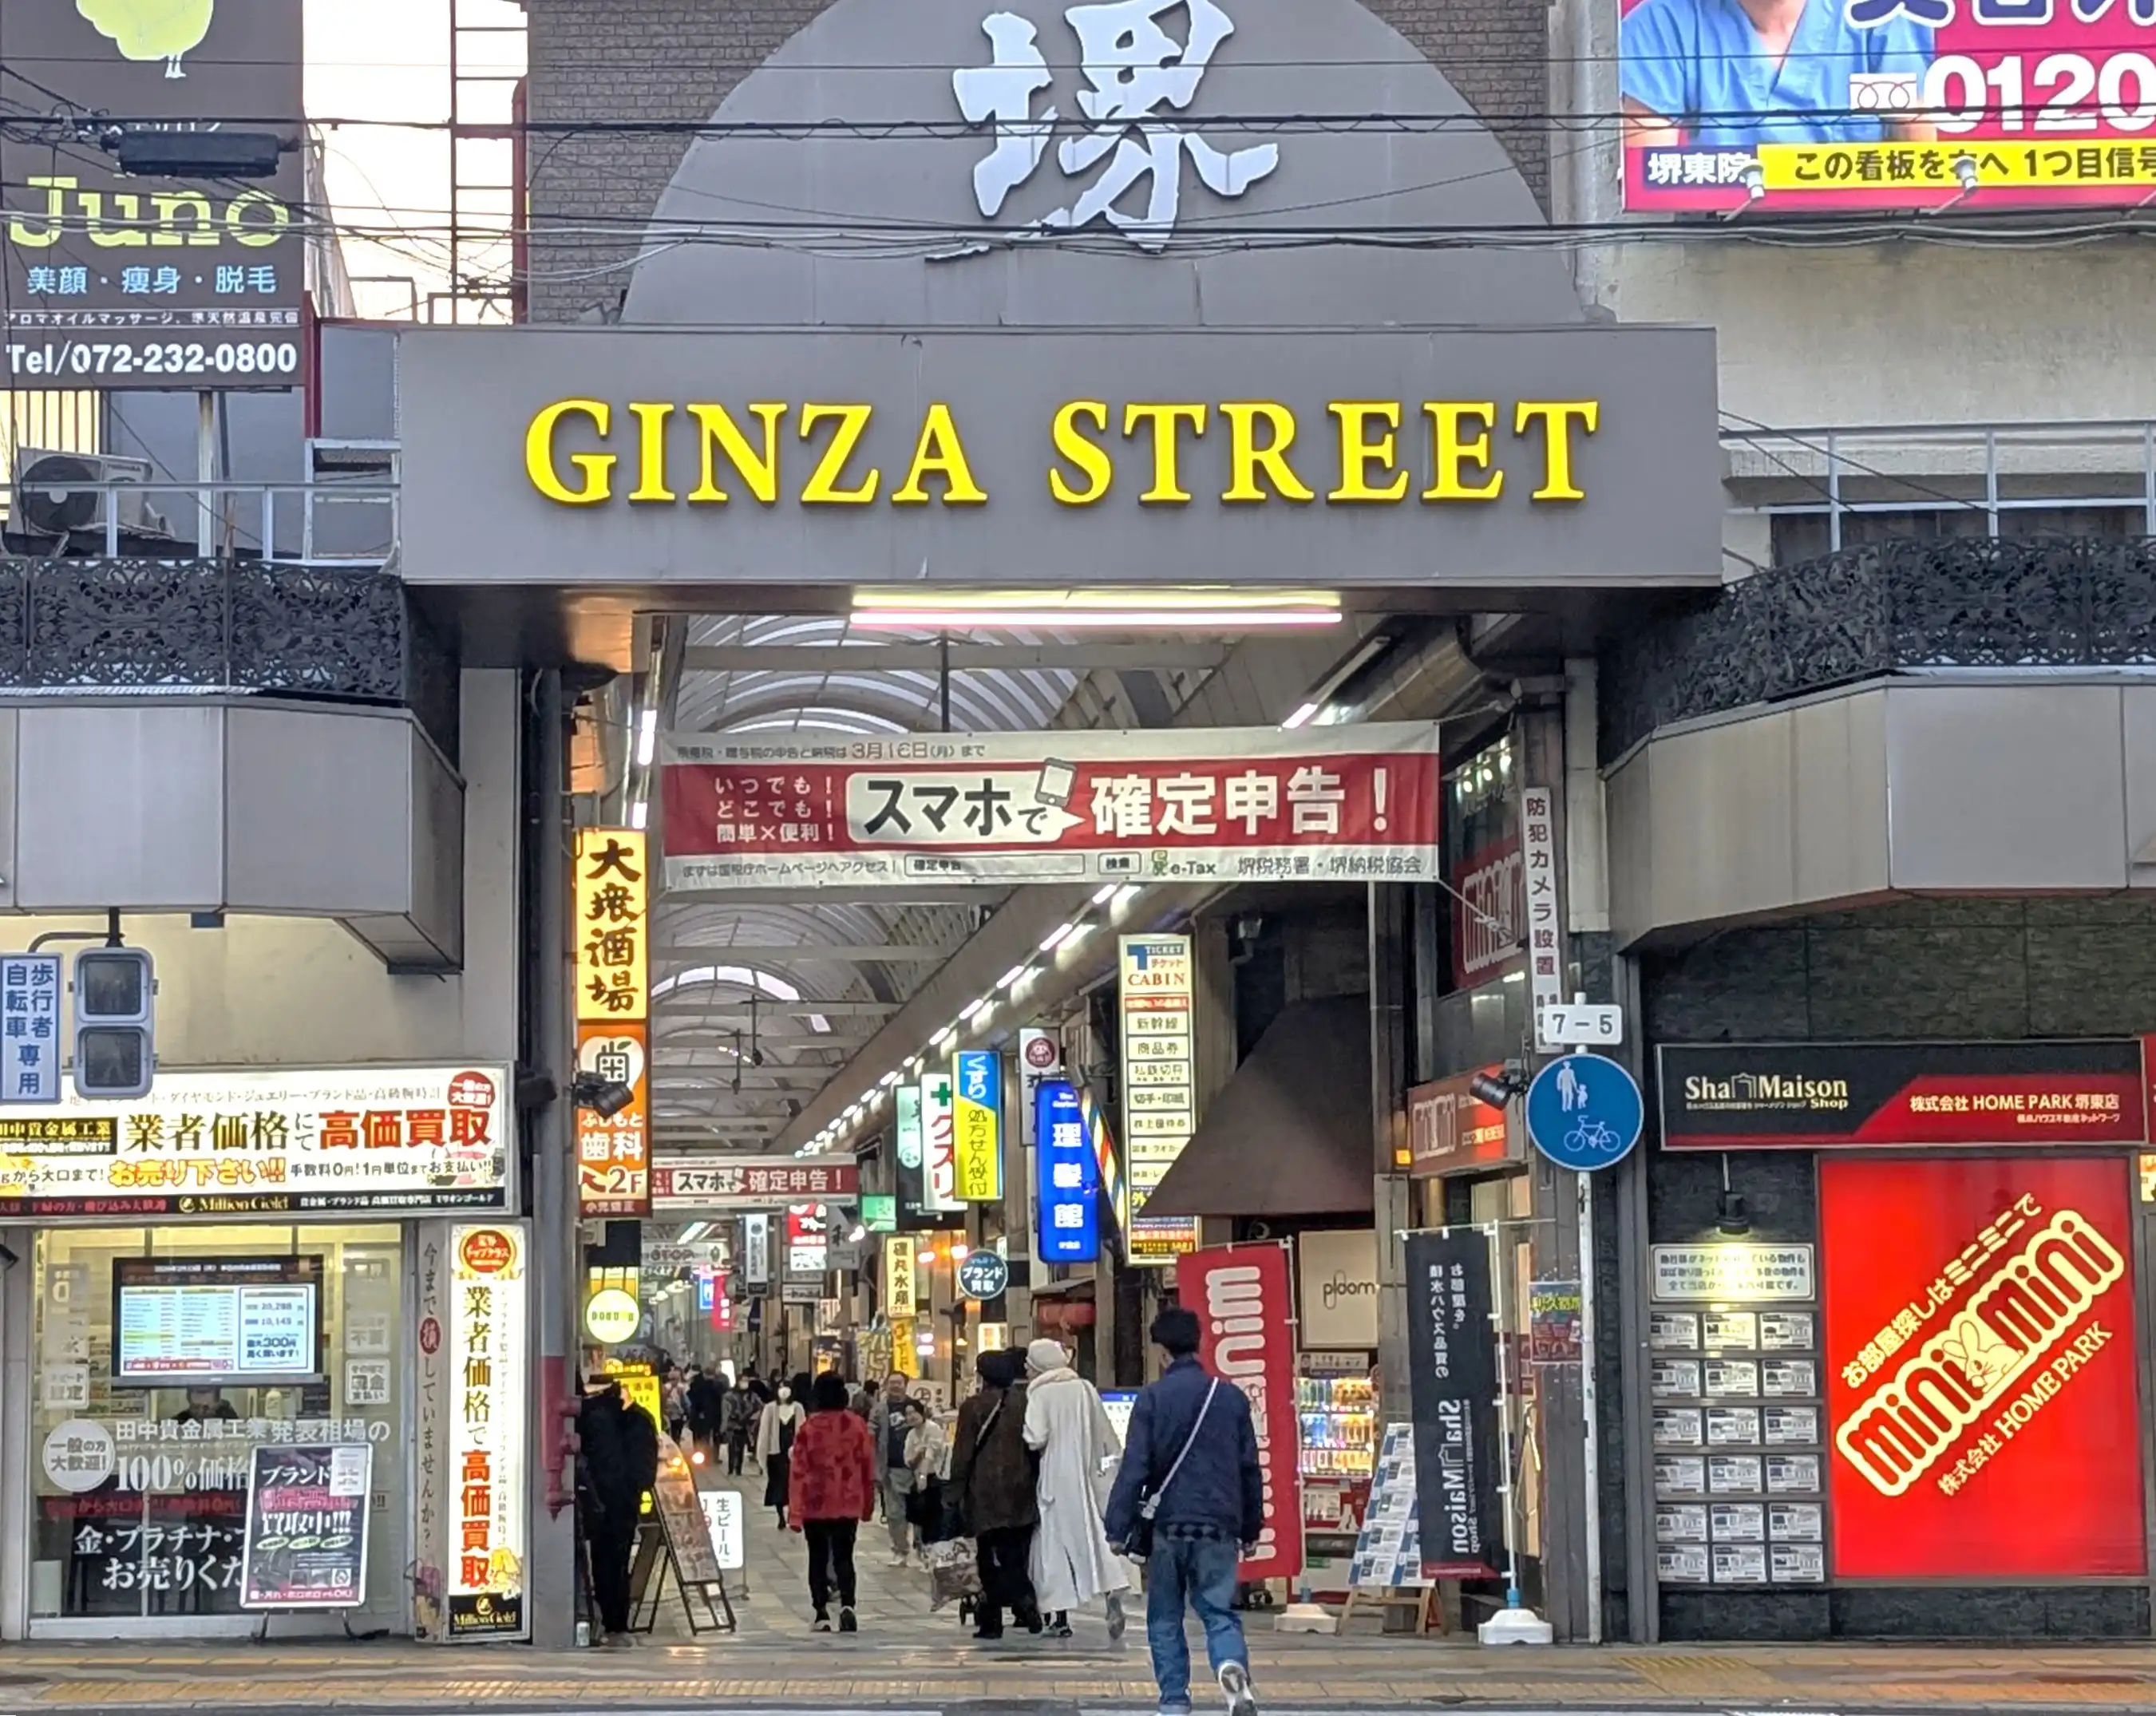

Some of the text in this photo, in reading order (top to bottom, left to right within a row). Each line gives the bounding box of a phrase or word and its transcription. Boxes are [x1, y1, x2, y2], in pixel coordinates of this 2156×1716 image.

[1924, 53, 2156, 133] 0120
[925, 0, 1279, 259] 堺
[1648, 153, 1748, 184] 堺東院
[10, 176, 290, 248] Juno
[526, 399, 1599, 505] GINZA STREET
[864, 778, 1048, 836] スマホで
[1171, 860, 1216, 876] e-Tax
[1527, 798, 1555, 975] 防犯カメラ設置
[585, 838, 642, 1012] 大衆酒場
[6, 963, 28, 1038] 自転車
[31, 963, 53, 1038] 歩行者
[1127, 972, 1185, 987] CABIN
[18, 1043, 41, 1094] 専用
[965, 1055, 989, 1099] くすり
[1684, 1074, 1848, 1100] Sha Maison
[1810, 1099, 1849, 1110] Shop
[1909, 1095, 1969, 1112] 株式会社
[1973, 1095, 2025, 1110] HOME
[2029, 1093, 2074, 1110] PARK
[581, 1131, 643, 1161] 歯科
[608, 1168, 643, 1194] 2F
[962, 1267, 1004, 1279] ブランド
[1323, 1269, 1375, 1310] ploom
[1842, 1192, 2041, 1388] お部屋探しはミニミニで
[1937, 1321, 2112, 1496] 株式会社 HOME PARK
